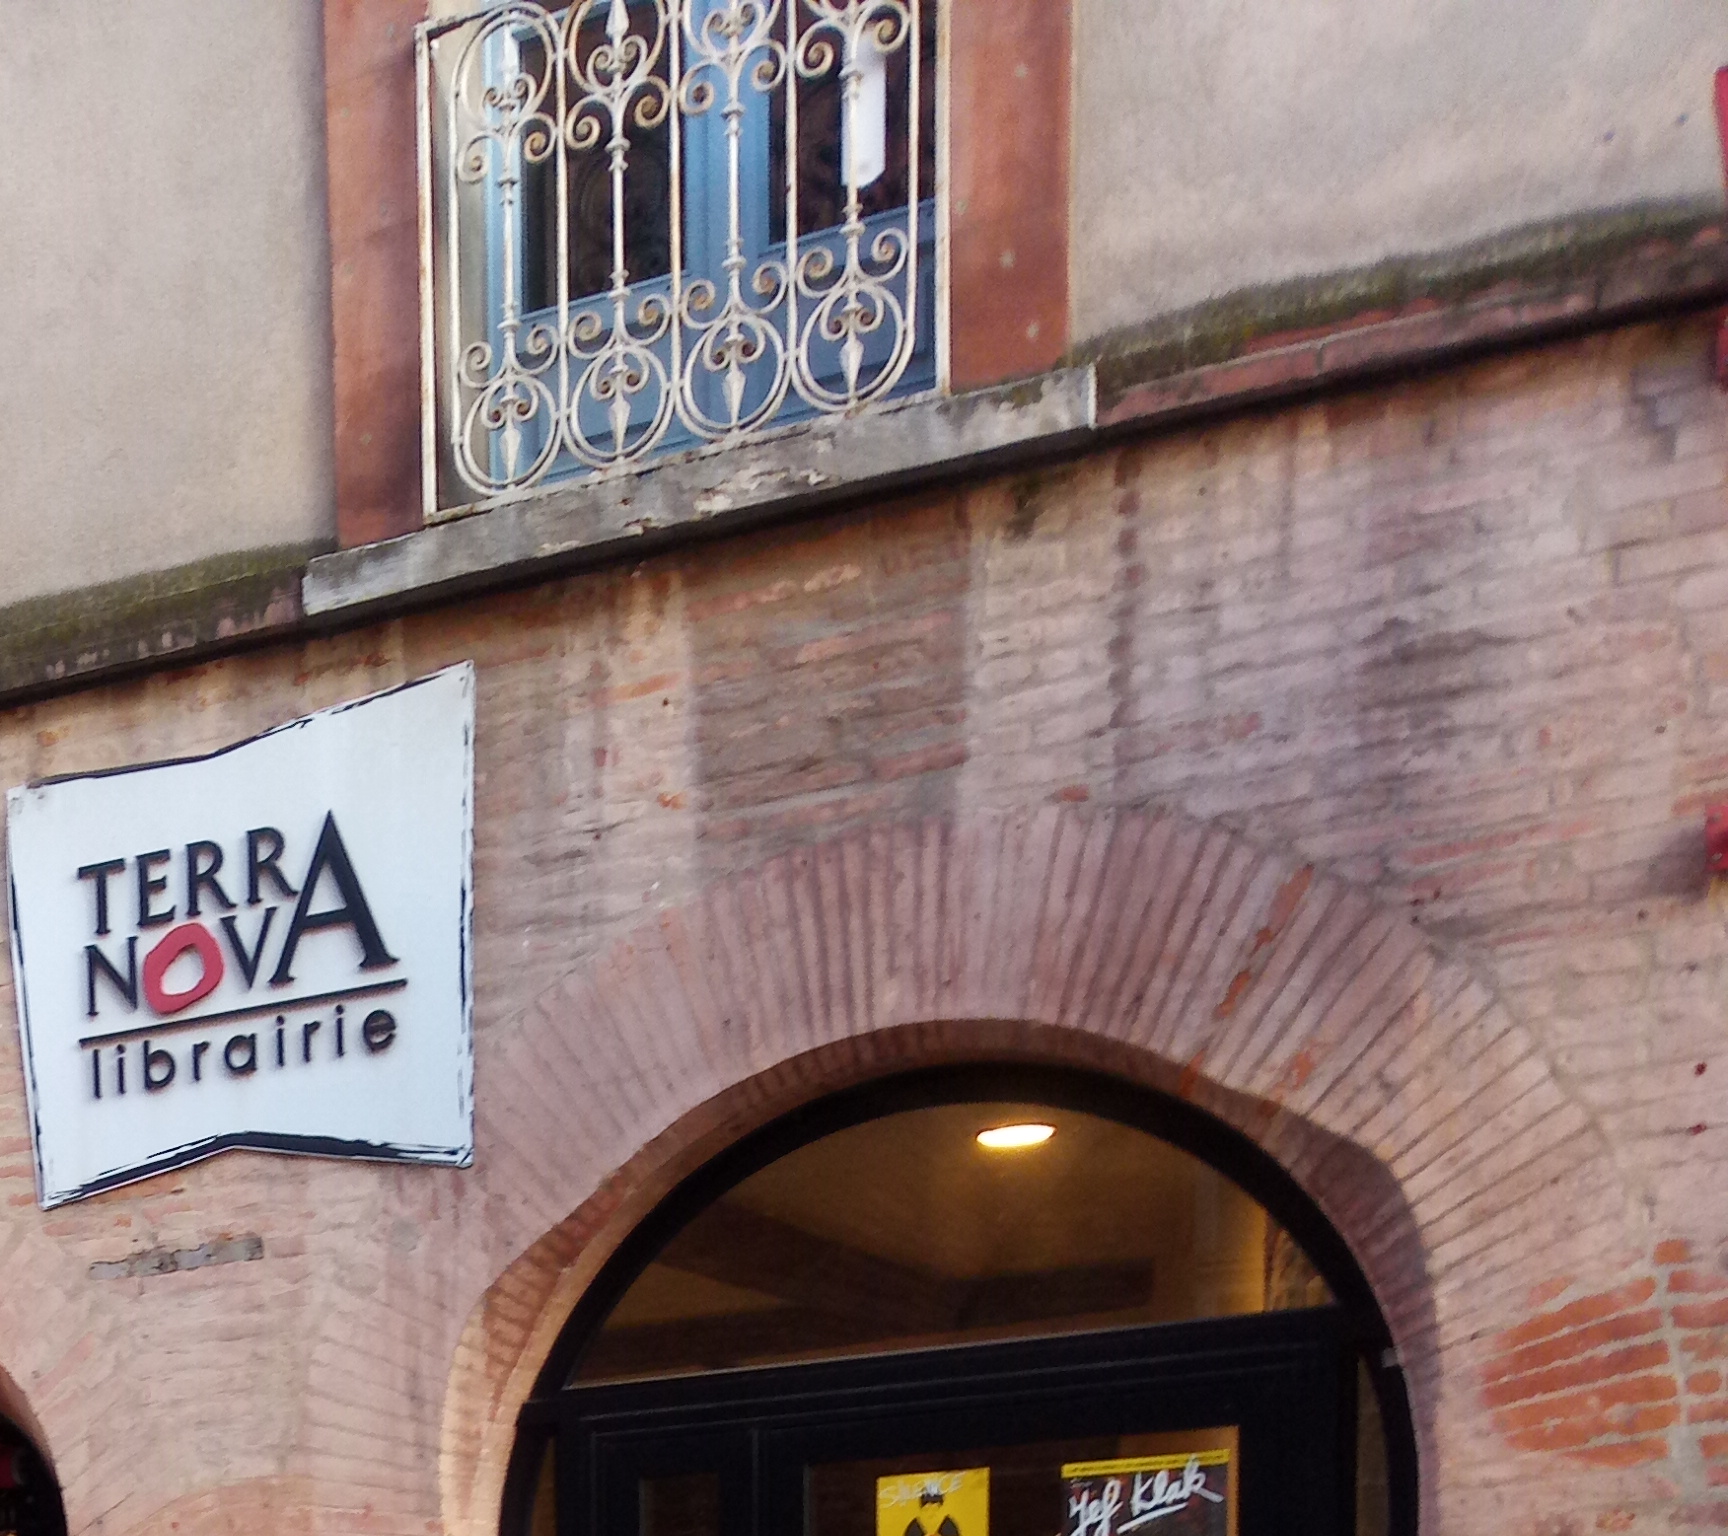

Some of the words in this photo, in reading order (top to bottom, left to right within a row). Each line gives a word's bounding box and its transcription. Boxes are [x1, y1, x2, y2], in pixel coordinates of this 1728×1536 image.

[77, 809, 400, 985] TERRA
[83, 809, 400, 1016] NOVA
[90, 1003, 398, 1099] librairie
